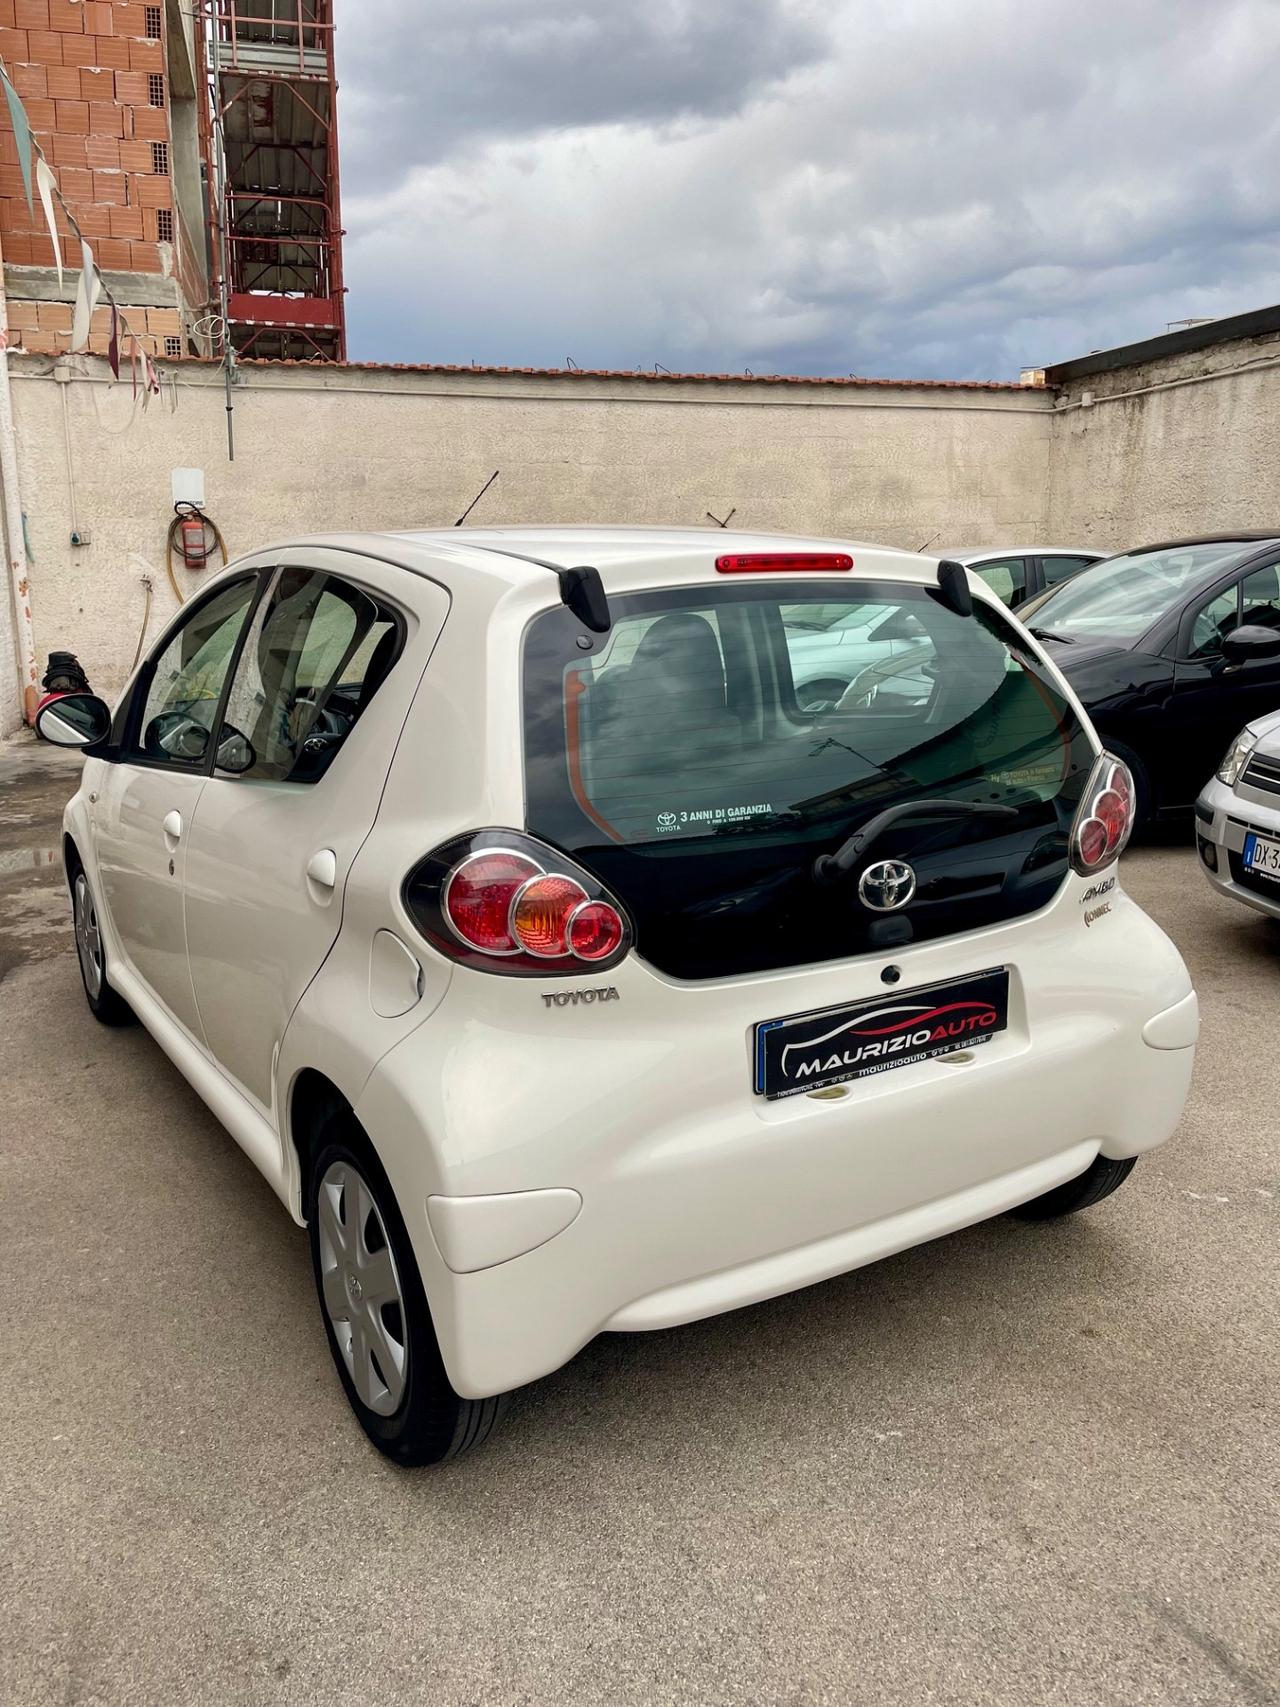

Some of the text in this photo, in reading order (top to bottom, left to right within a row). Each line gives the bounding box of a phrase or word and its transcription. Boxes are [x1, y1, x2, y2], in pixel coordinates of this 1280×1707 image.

[680, 803, 772, 822] 3 ANNI DI GARANZIA
[541, 985, 620, 1008] TOYOTA
[859, 1052, 927, 1077] maurizioauto
